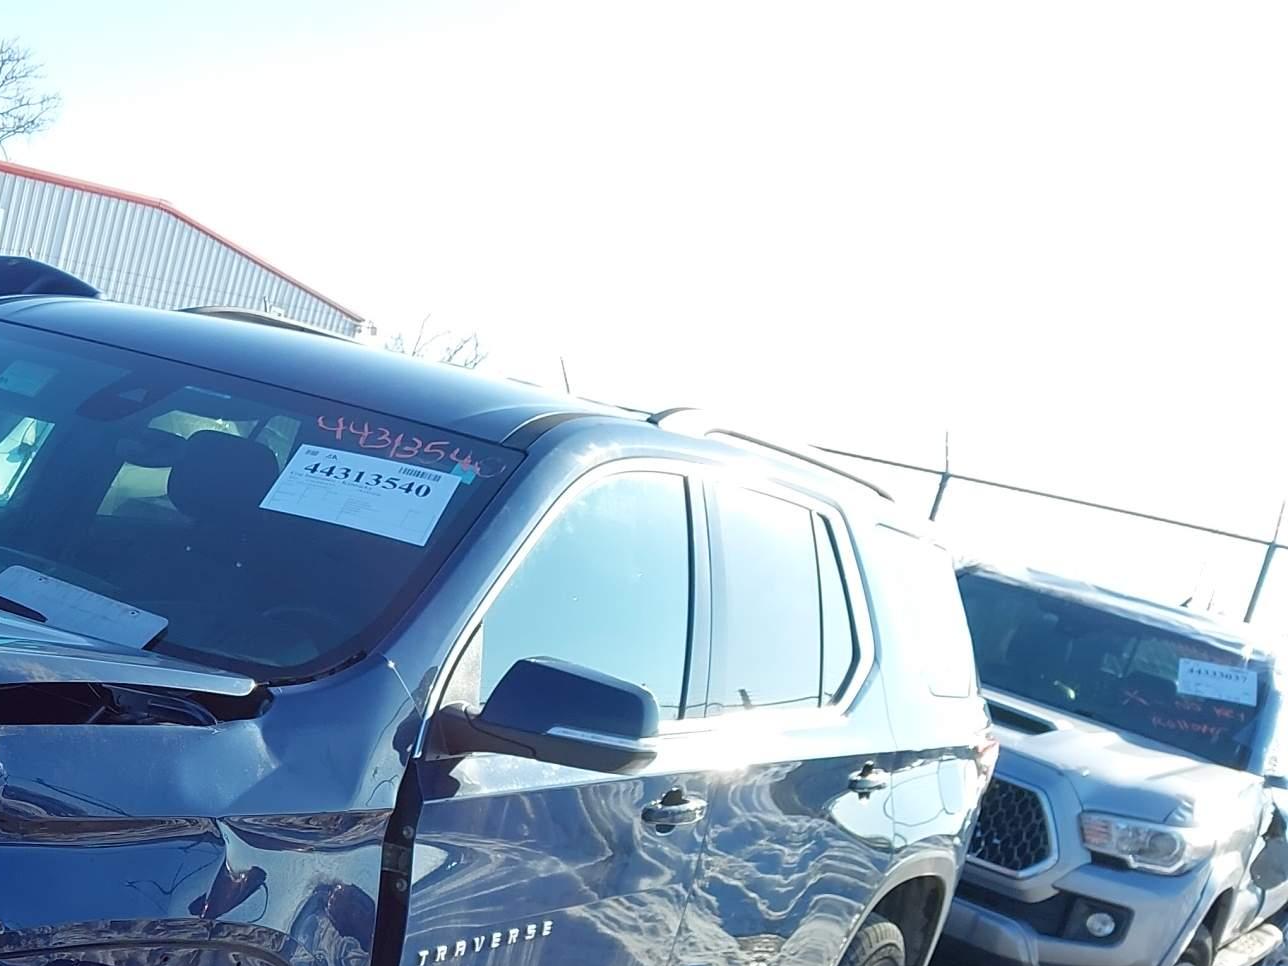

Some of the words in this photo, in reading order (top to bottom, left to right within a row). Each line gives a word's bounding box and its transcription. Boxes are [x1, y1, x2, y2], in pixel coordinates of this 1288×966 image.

[316, 415, 506, 479] 44313540
[304, 462, 432, 498] 44313540
[417, 920, 554, 966] TRAVERSE
